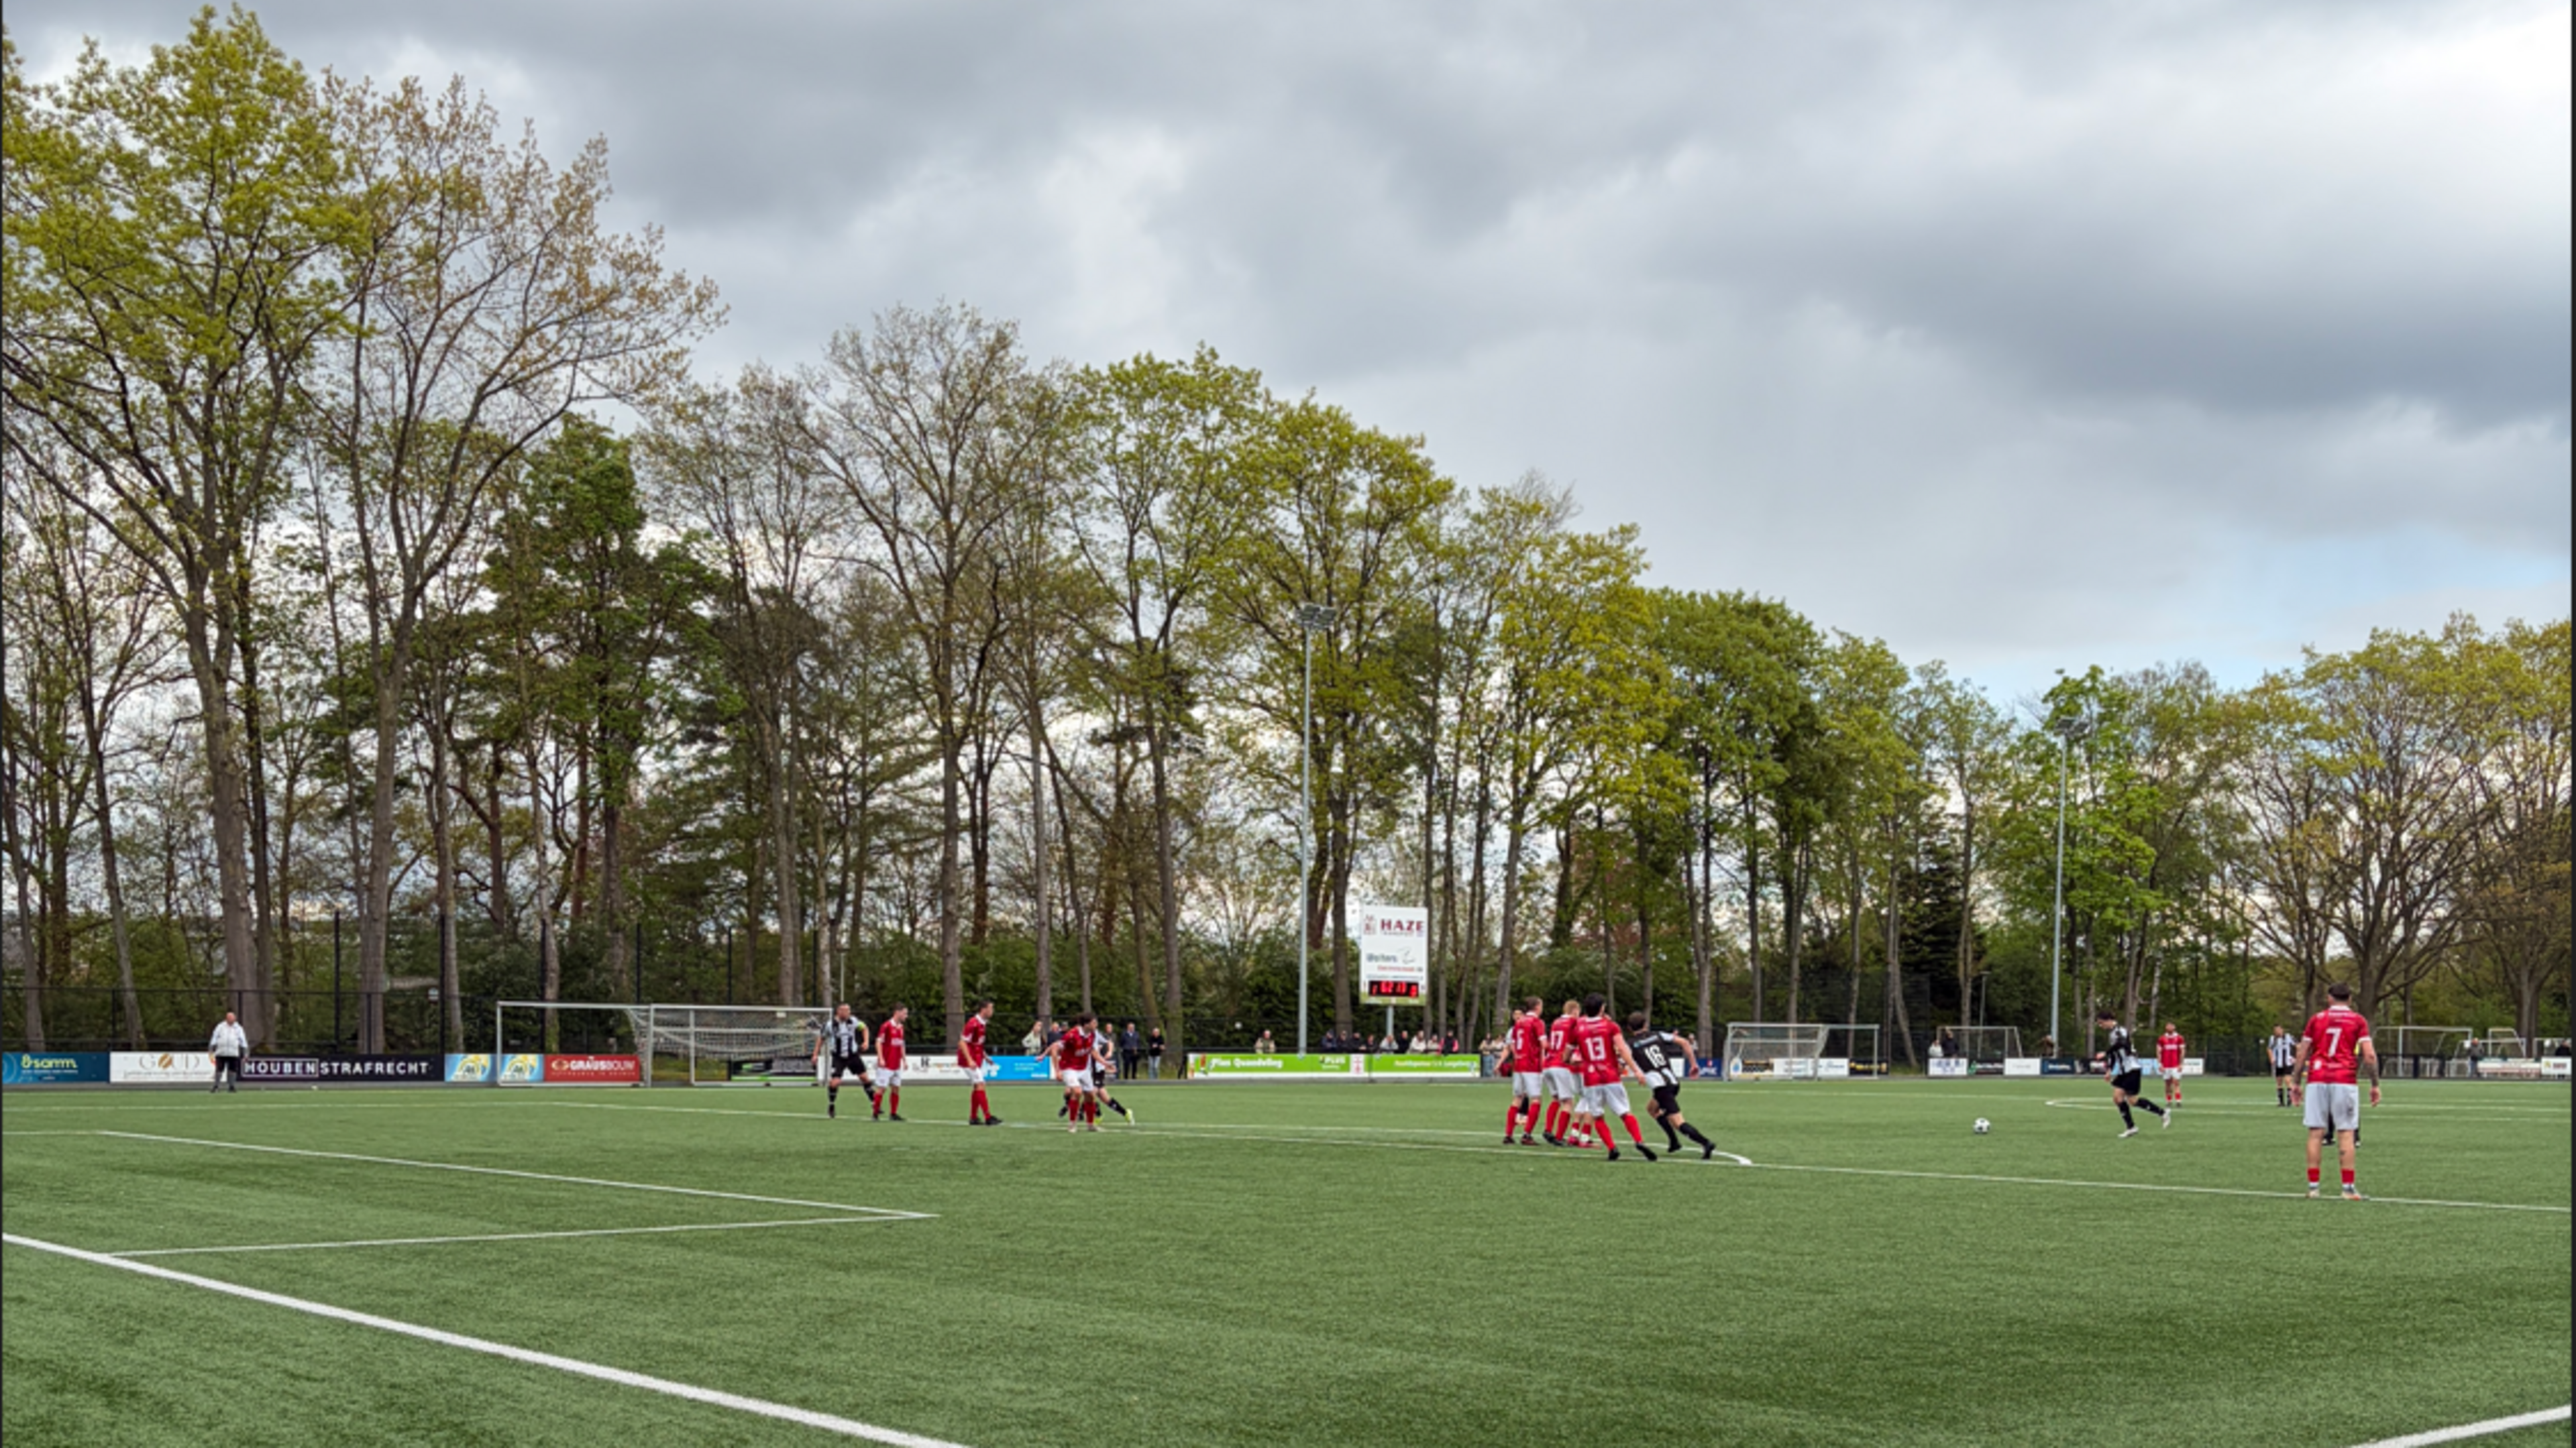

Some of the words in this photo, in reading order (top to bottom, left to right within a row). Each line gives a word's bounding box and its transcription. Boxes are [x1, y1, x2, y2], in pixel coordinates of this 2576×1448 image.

[1381, 919, 1424, 932] HAZE
[1550, 1030, 1564, 1050] 17
[1585, 1036, 1606, 1061] 13
[2326, 1027, 2342, 1057] 7
[1644, 1044, 1666, 1068] 16
